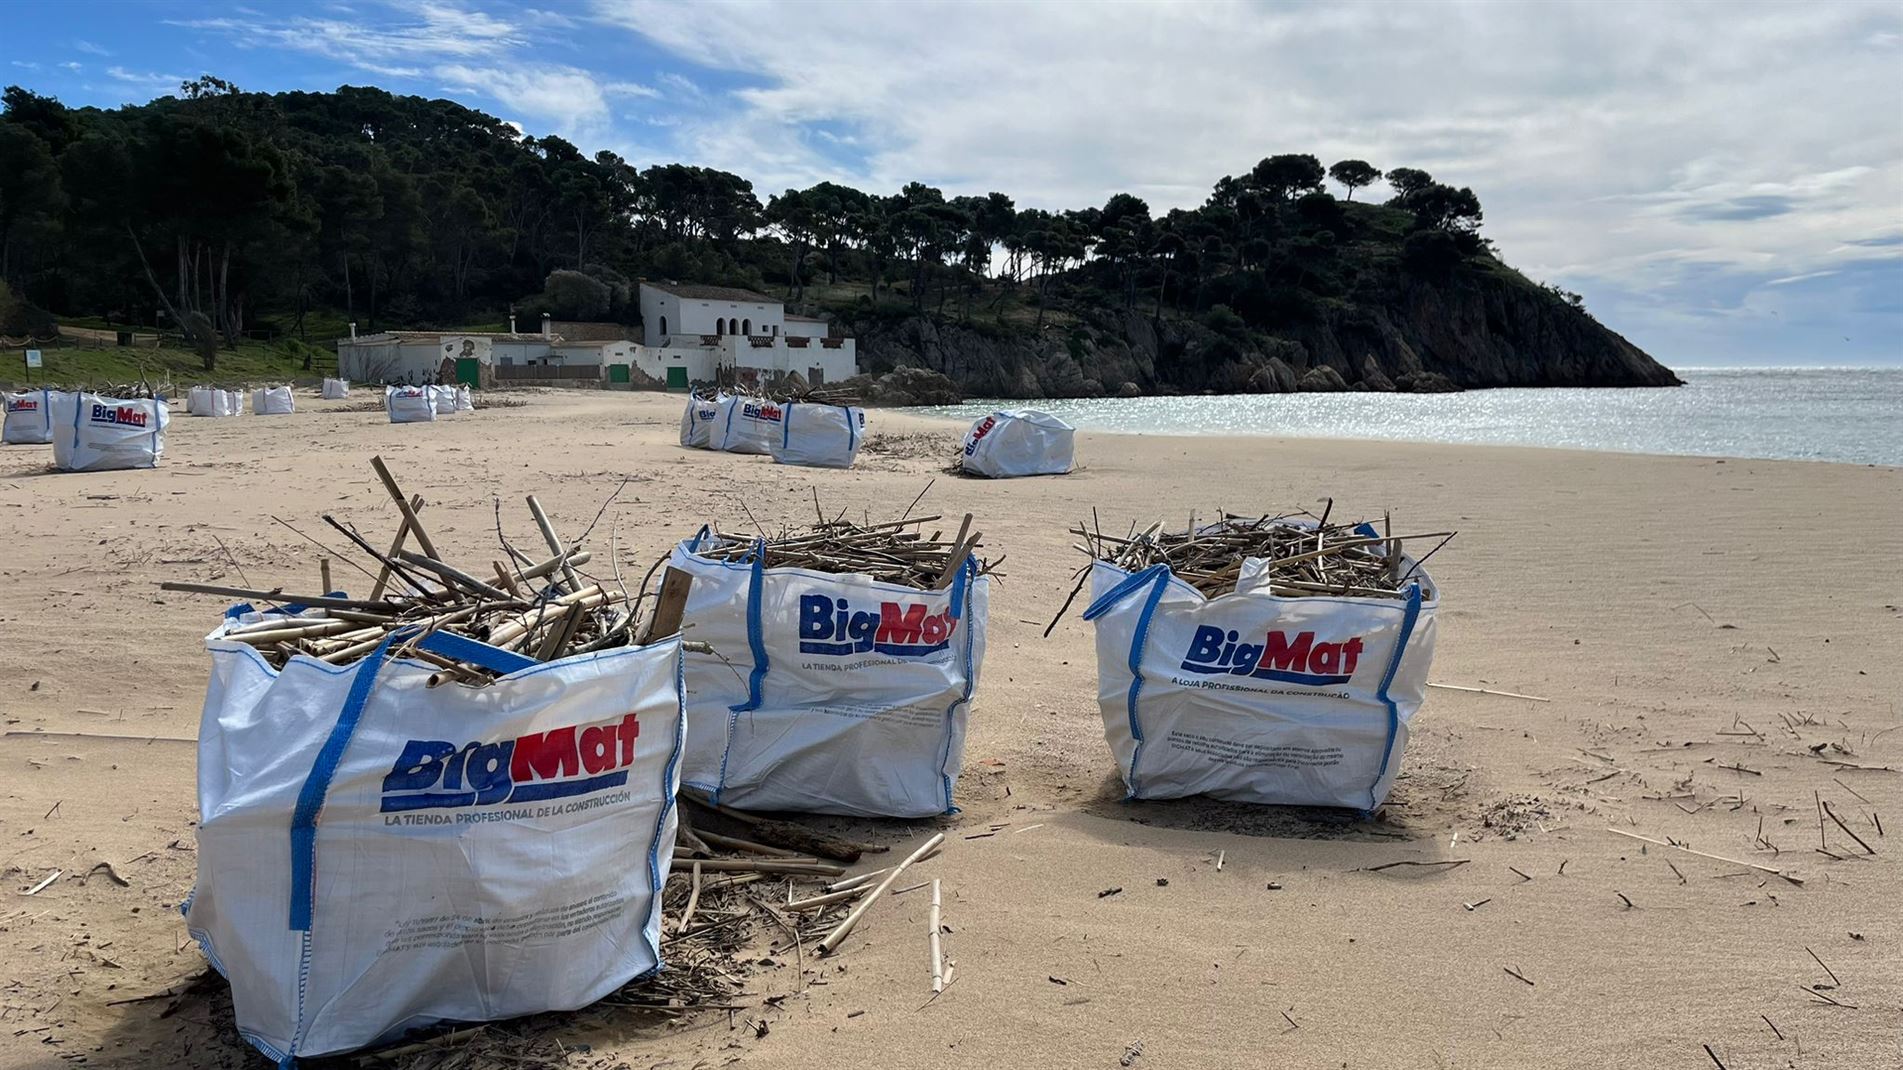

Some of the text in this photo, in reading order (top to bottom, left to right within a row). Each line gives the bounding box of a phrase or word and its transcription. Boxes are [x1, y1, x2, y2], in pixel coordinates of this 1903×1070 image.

[91, 404, 147, 427] BigMat
[814, 663, 842, 672] TIENDA
[844, 659, 896, 671] PROFESIONAL
[1183, 625, 1364, 682] BigMat
[1171, 677, 1178, 685] A
[1179, 679, 1200, 688] LOJA
[1202, 681, 1269, 694] PROFISSIONAL
[381, 713, 640, 806] BigMat
[384, 790, 631, 826] LA TIENDA PROFESIONAL DE LA CONSTRUCCIÓN
